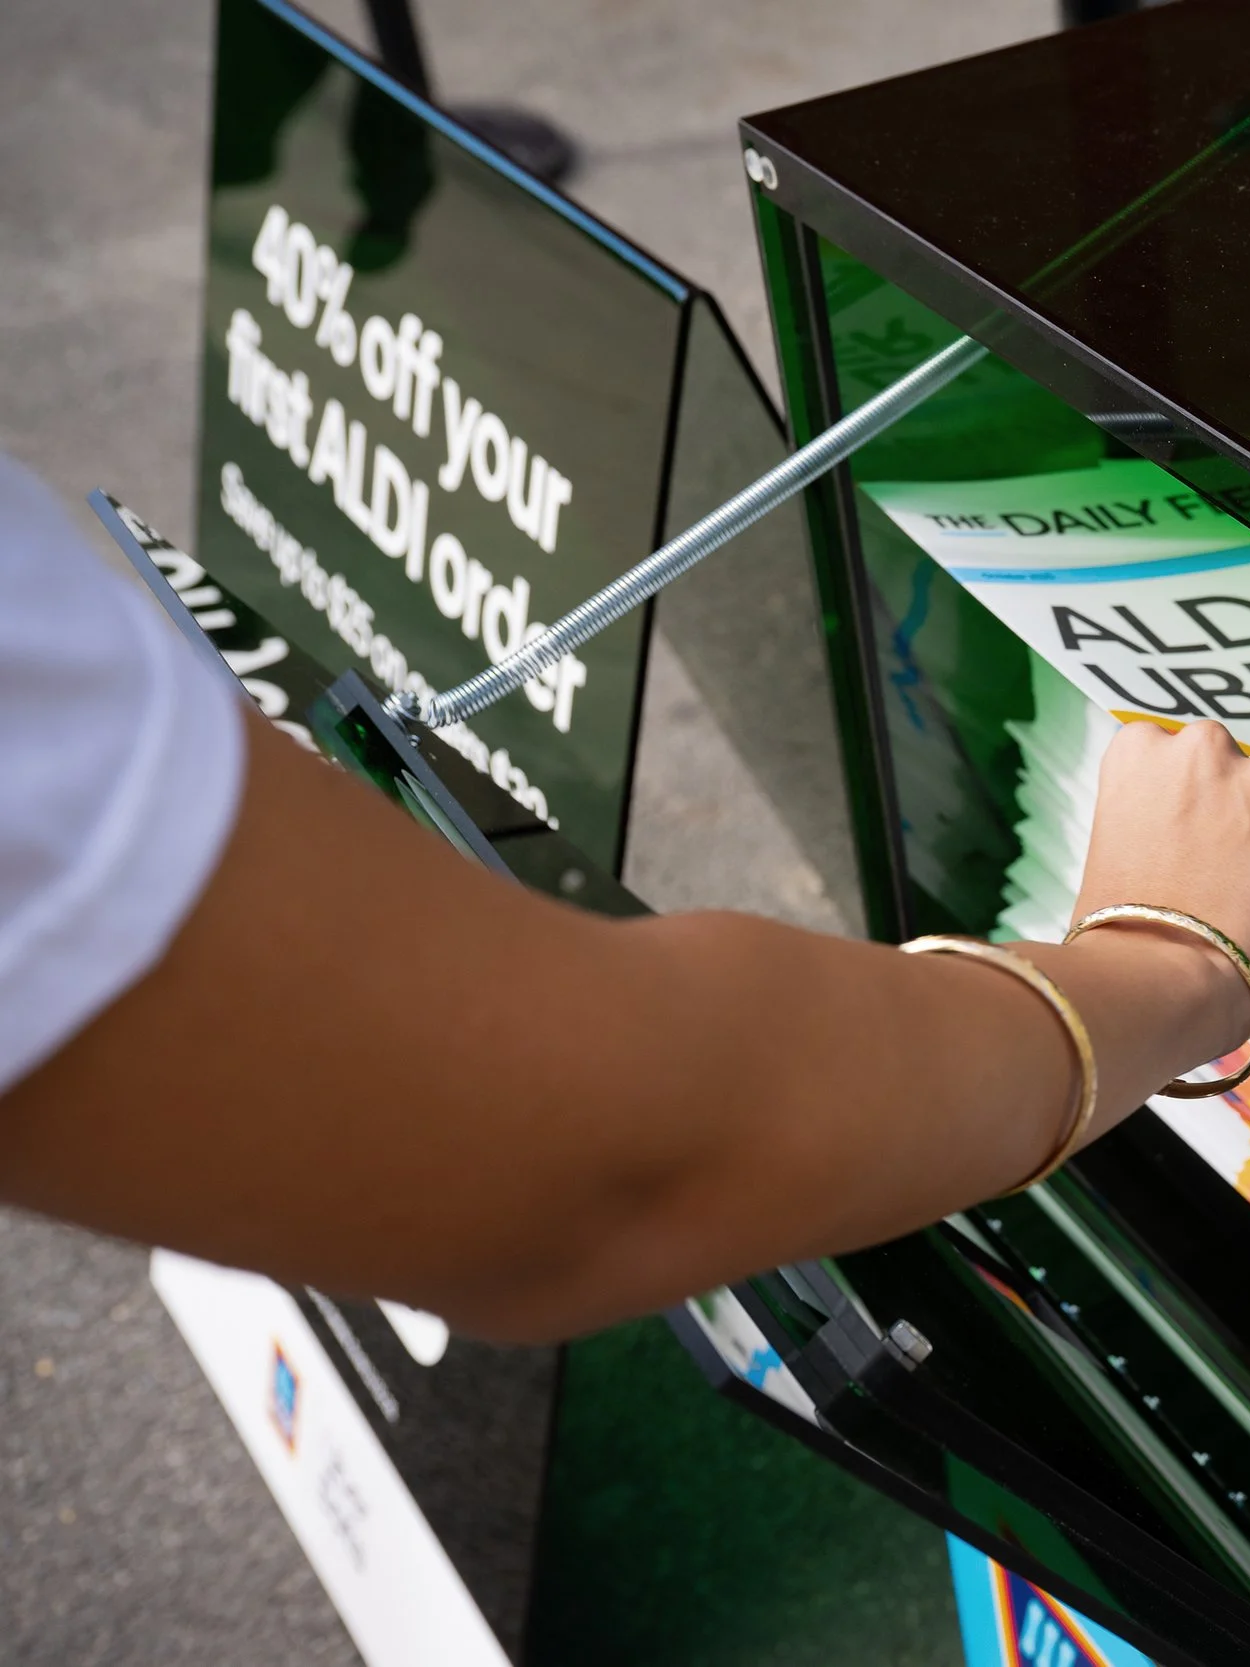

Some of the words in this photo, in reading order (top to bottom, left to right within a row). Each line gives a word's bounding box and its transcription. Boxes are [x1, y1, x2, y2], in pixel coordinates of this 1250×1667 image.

[225, 308, 312, 468] first
[309, 399, 429, 582] ALDI
[252, 204, 356, 367] 40%
[360, 312, 443, 438] off
[439, 377, 573, 553] your
[925, 513, 995, 530] THE
[1002, 499, 1158, 537] DAILY
